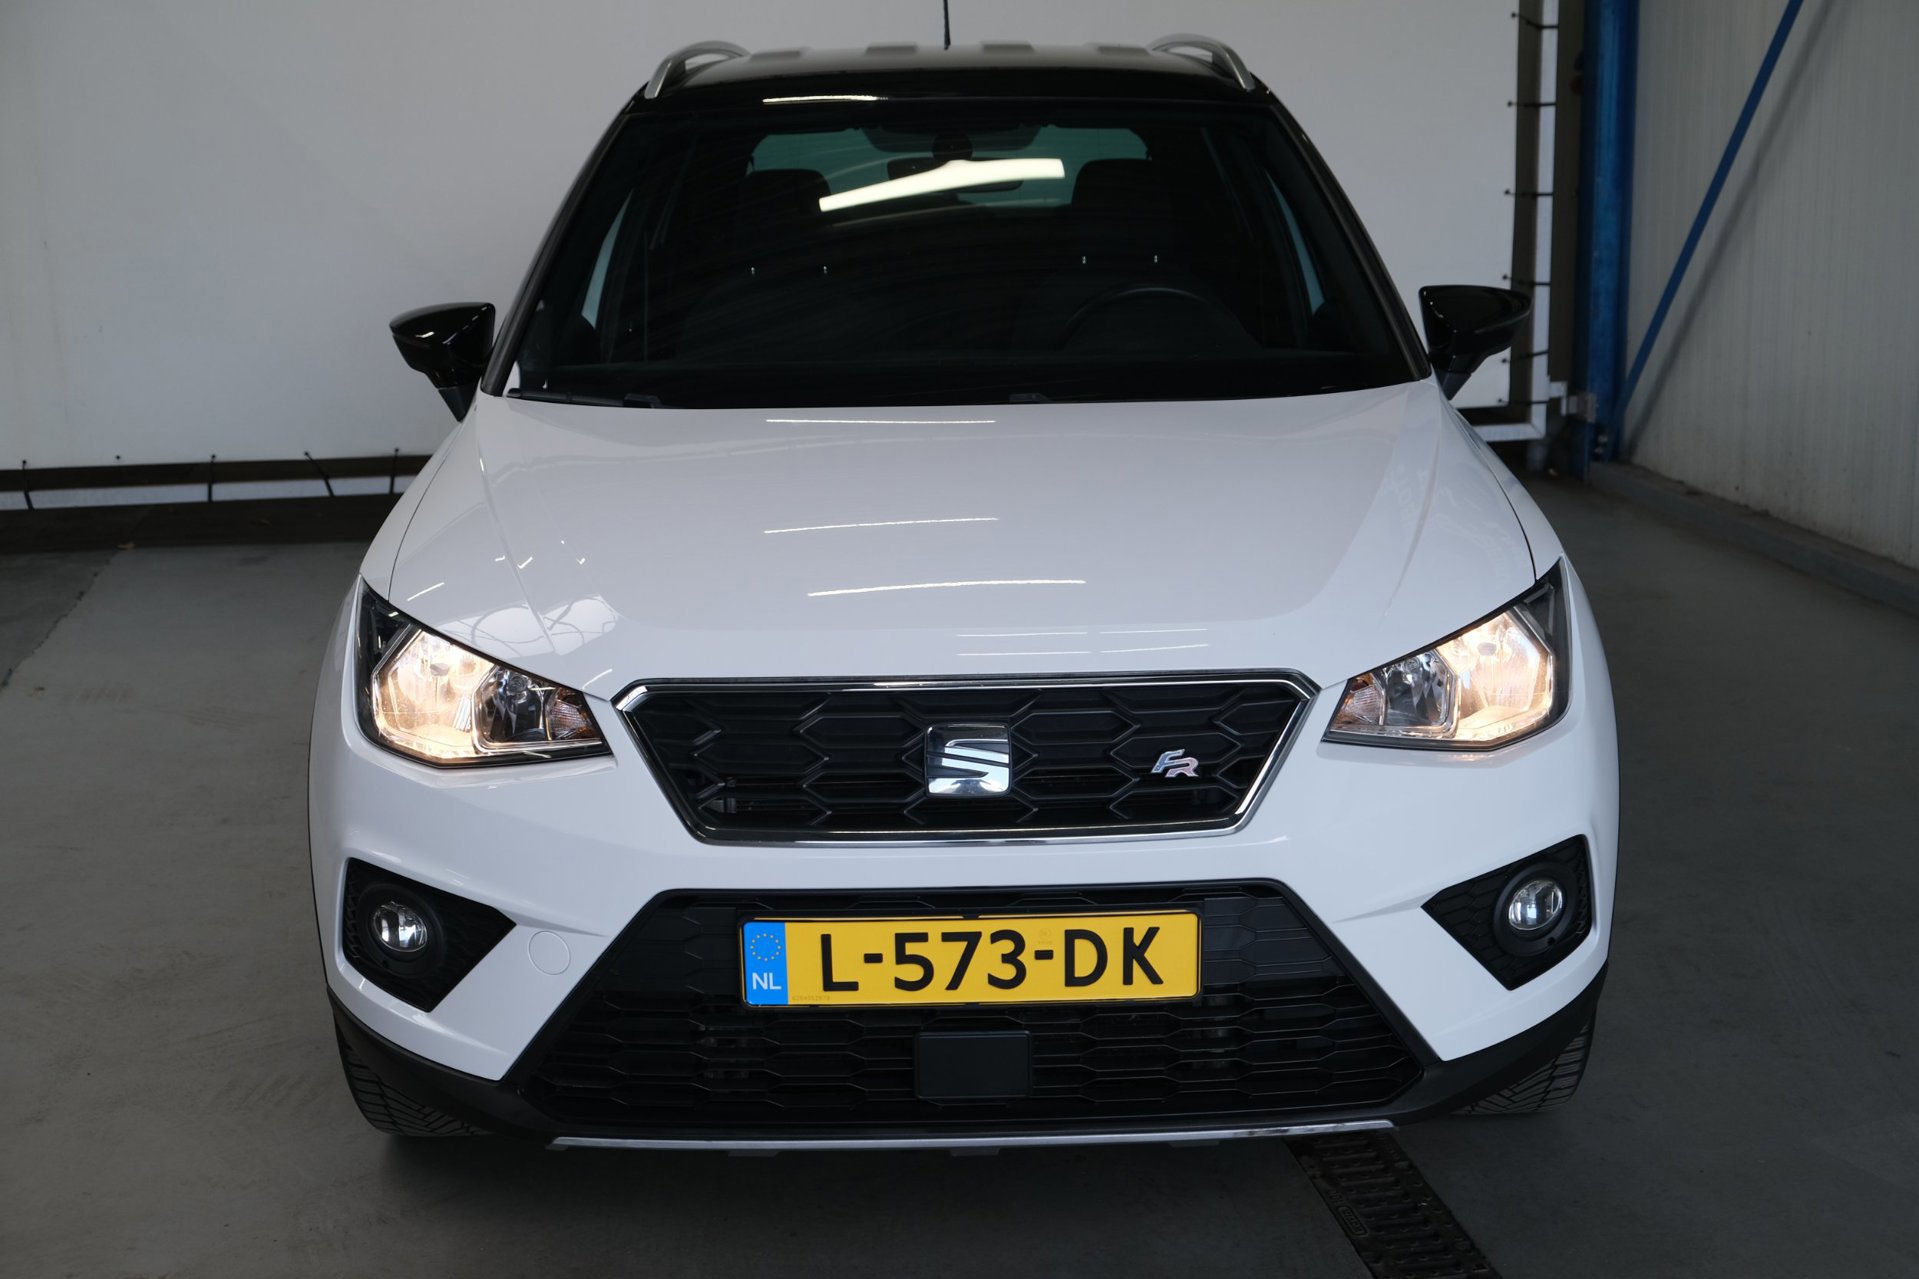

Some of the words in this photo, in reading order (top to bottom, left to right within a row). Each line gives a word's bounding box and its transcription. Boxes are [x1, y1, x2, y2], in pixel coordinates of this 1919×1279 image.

[1150, 748, 1199, 778] FR
[820, 926, 1164, 992] L-573-DK
[752, 972, 782, 990] NL
